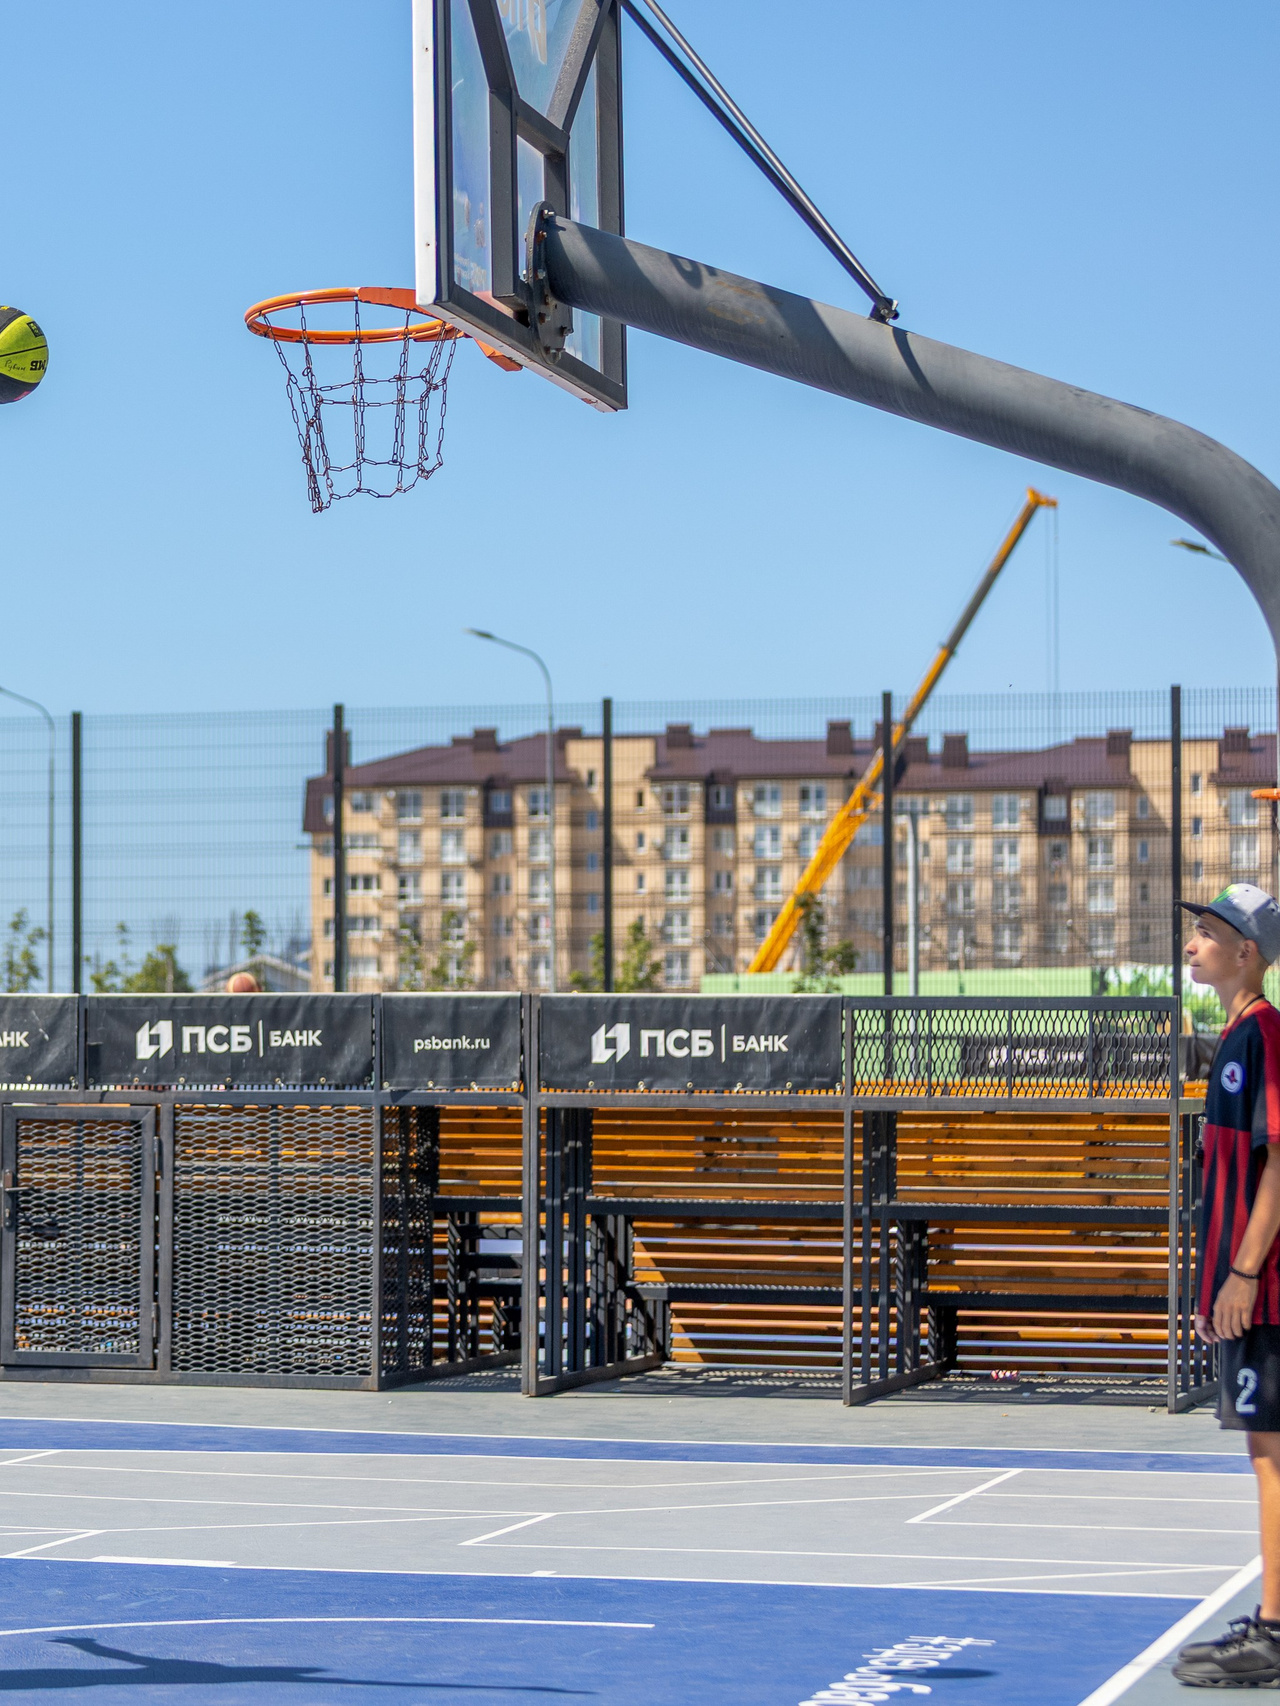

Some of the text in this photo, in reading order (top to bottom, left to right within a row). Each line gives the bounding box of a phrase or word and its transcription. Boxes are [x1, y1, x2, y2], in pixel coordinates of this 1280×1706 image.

[182, 1025, 322, 1053] ПСБ БАНК
[414, 1035, 490, 1053] psbank.ru
[640, 1029, 788, 1058] ПСБ БАНК
[1236, 1369, 1255, 1412] 2
